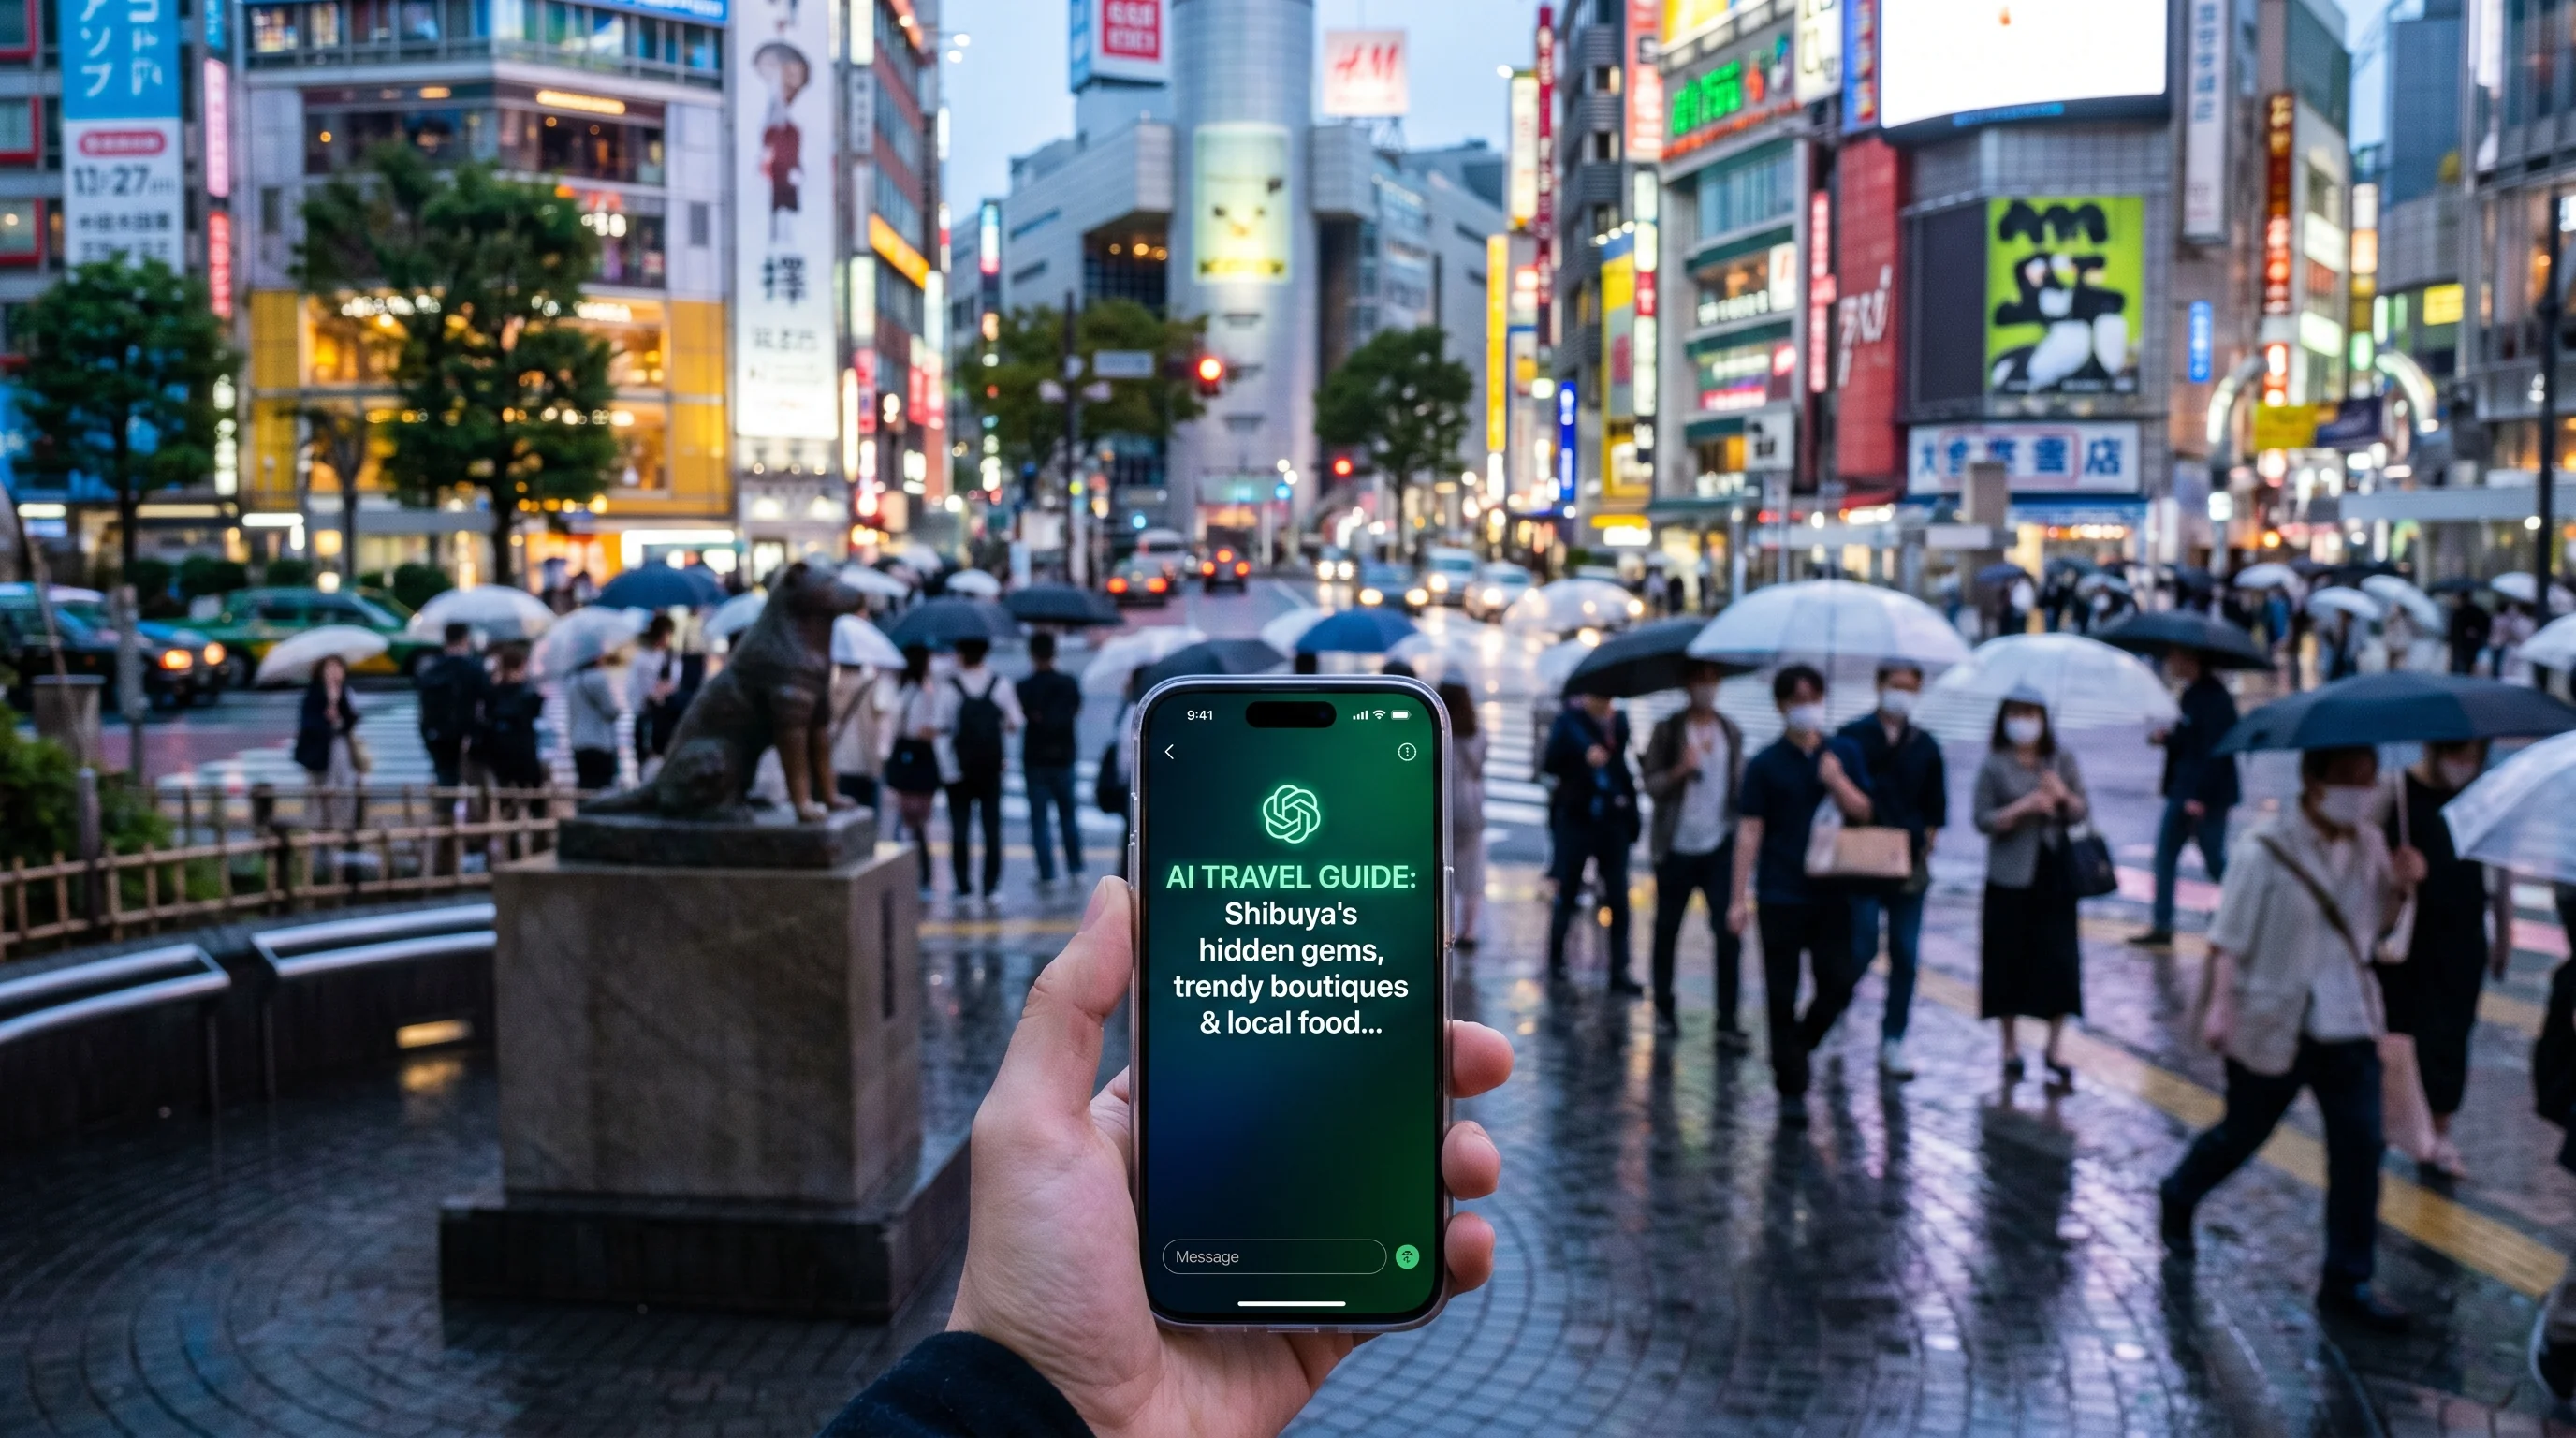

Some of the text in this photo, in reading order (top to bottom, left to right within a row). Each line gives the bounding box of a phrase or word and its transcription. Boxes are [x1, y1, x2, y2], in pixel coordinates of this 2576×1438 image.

[1186, 710, 1214, 721] 9:41
[1166, 864, 1416, 889] AI TRAVEL GUIDE:
[1224, 901, 1357, 932] Shibuya's
[1199, 937, 1384, 968] hidden gems,
[1173, 974, 1409, 1004] trendy boutiques
[1200, 1009, 1383, 1034] & local food...
[1176, 1250, 1239, 1267] Message
